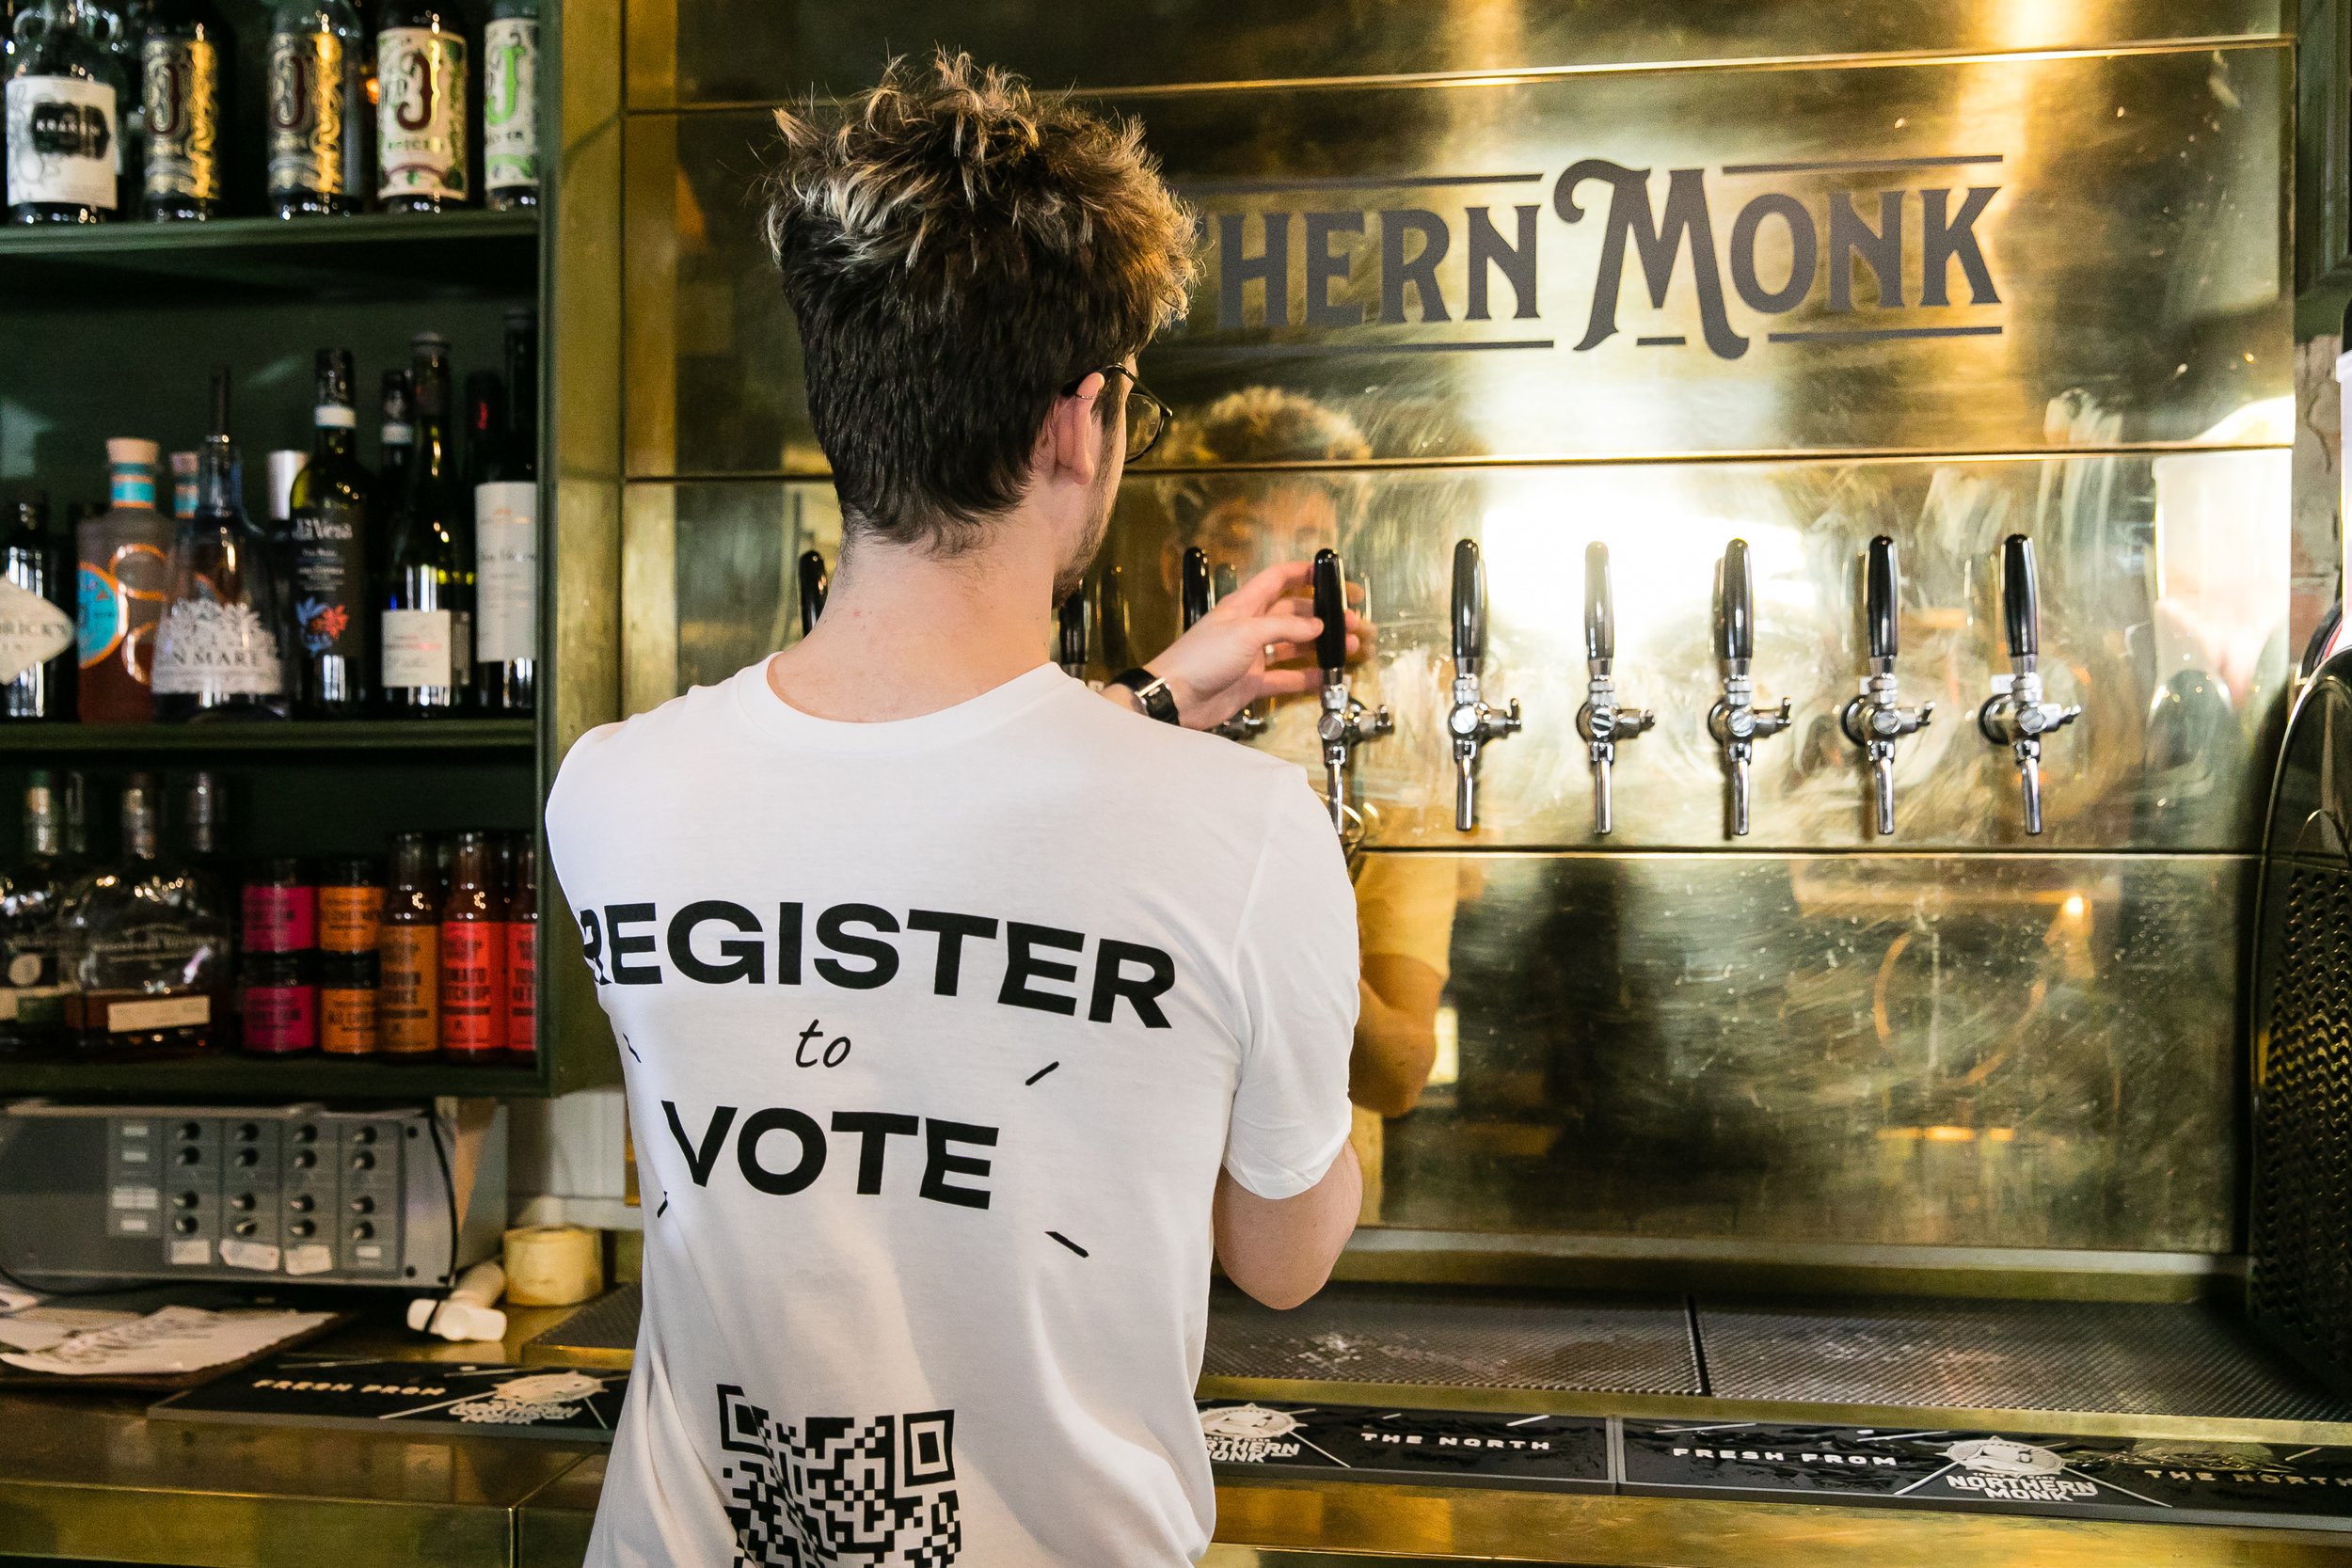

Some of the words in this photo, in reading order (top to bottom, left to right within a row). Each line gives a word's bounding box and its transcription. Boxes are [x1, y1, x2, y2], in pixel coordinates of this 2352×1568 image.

[1195, 204, 1540, 329] HERN
[580, 899, 1175, 1029] REGISTER
[795, 1019, 851, 1069] to
[661, 1100, 1000, 1211] VOTE
[1204, 1438, 1300, 1457] RTHERN
[1360, 1433, 1423, 1445] THE
[1438, 1436, 1550, 1450] NORTH
[1208, 1449, 1265, 1464] ONK
[1672, 1448, 1785, 1462] FRESH
[1801, 1453, 1898, 1466] FROM
[1946, 1475, 2099, 1497] NORTHERN
[1983, 1488, 2074, 1502] MONK
